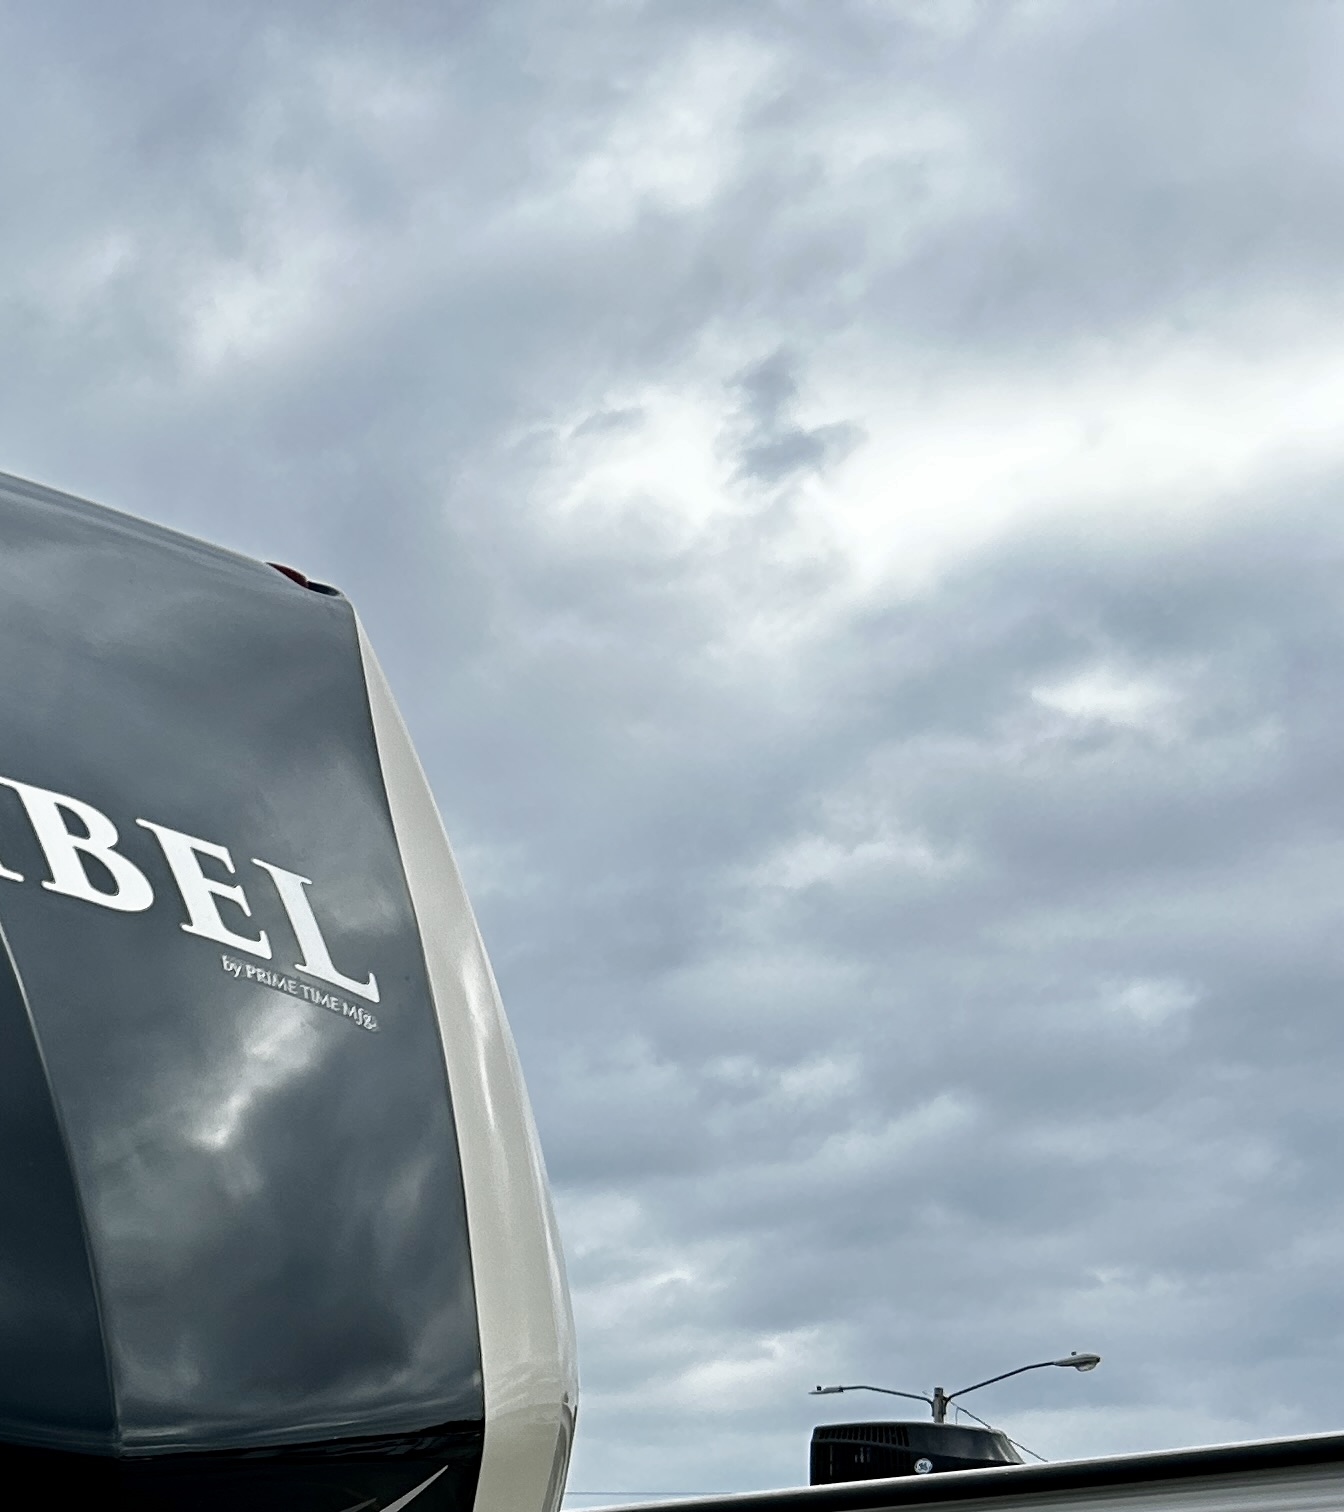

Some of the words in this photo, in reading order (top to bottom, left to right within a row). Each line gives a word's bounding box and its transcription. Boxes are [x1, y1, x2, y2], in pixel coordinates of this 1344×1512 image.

[221, 954, 242, 978] by
[245, 963, 298, 994] PRIME
[300, 983, 340, 1011] TIME
